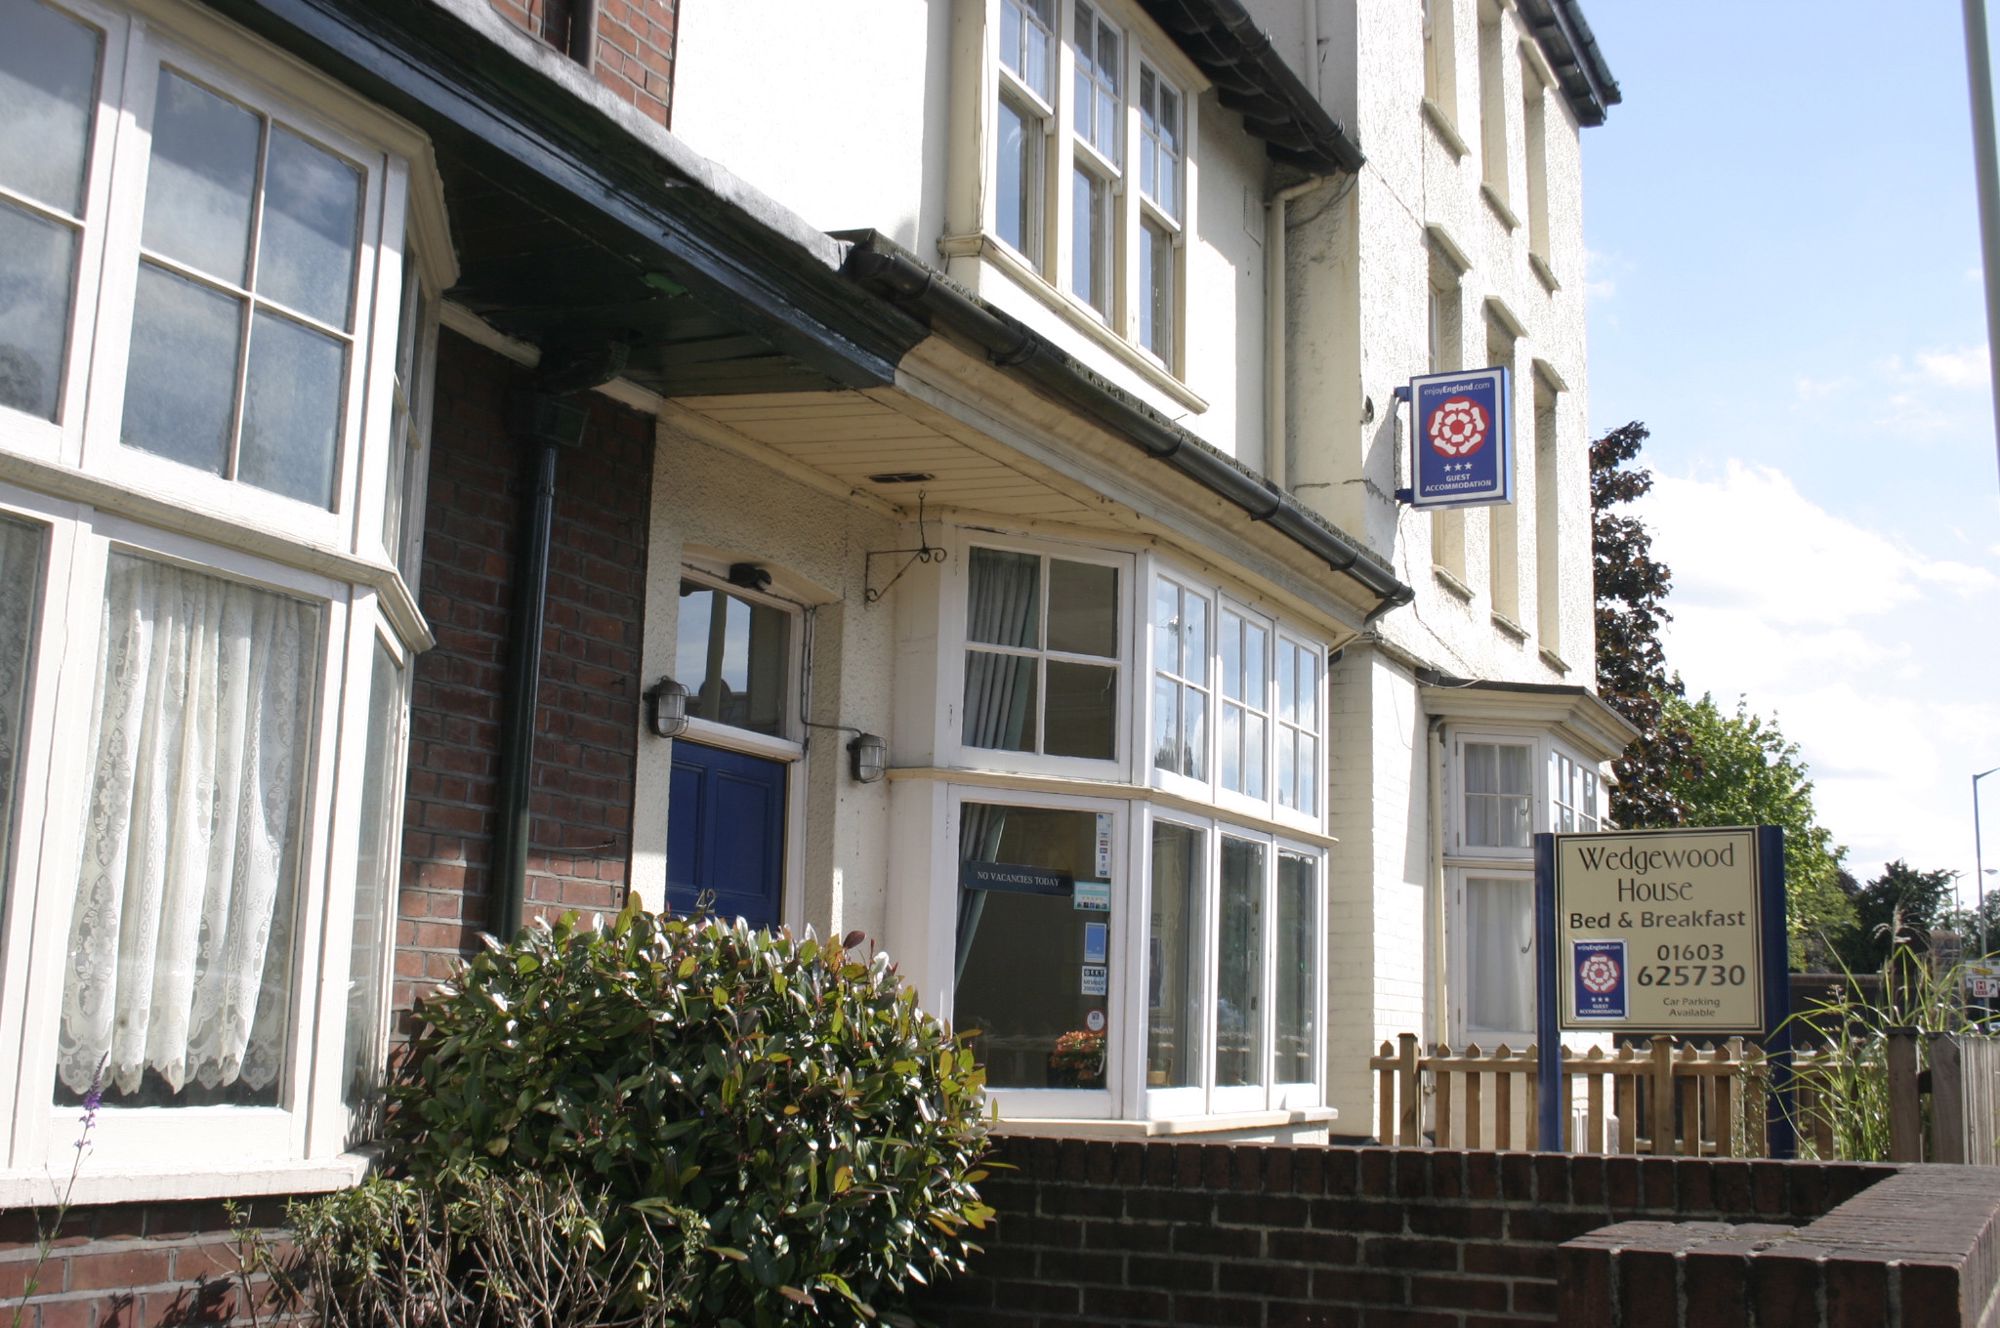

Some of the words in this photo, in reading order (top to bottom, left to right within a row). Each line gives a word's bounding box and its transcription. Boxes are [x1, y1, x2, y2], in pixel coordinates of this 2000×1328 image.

[1424, 382, 1490, 396] enjoyEngland.com
[1446, 473, 1471, 482] GUEST
[1425, 480, 1491, 492] ACCOMMODATION
[1578, 842, 1734, 876] Wedgewood
[977, 871, 989, 880] NO
[991, 872, 1033, 884] VACANCIES
[1034, 876, 1059, 887] TODAY
[1618, 878, 1694, 902] House
[696, 888, 717, 914] 42
[1570, 912, 1611, 929] Bed
[1618, 911, 1633, 928] &
[1641, 910, 1746, 928] Breakfast
[1657, 944, 1724, 961] 01603
[1637, 965, 1745, 986] 625730
[1663, 998, 1679, 1006] Car
[1682, 998, 1721, 1008] Parking
[1669, 1008, 1716, 1017] Available
